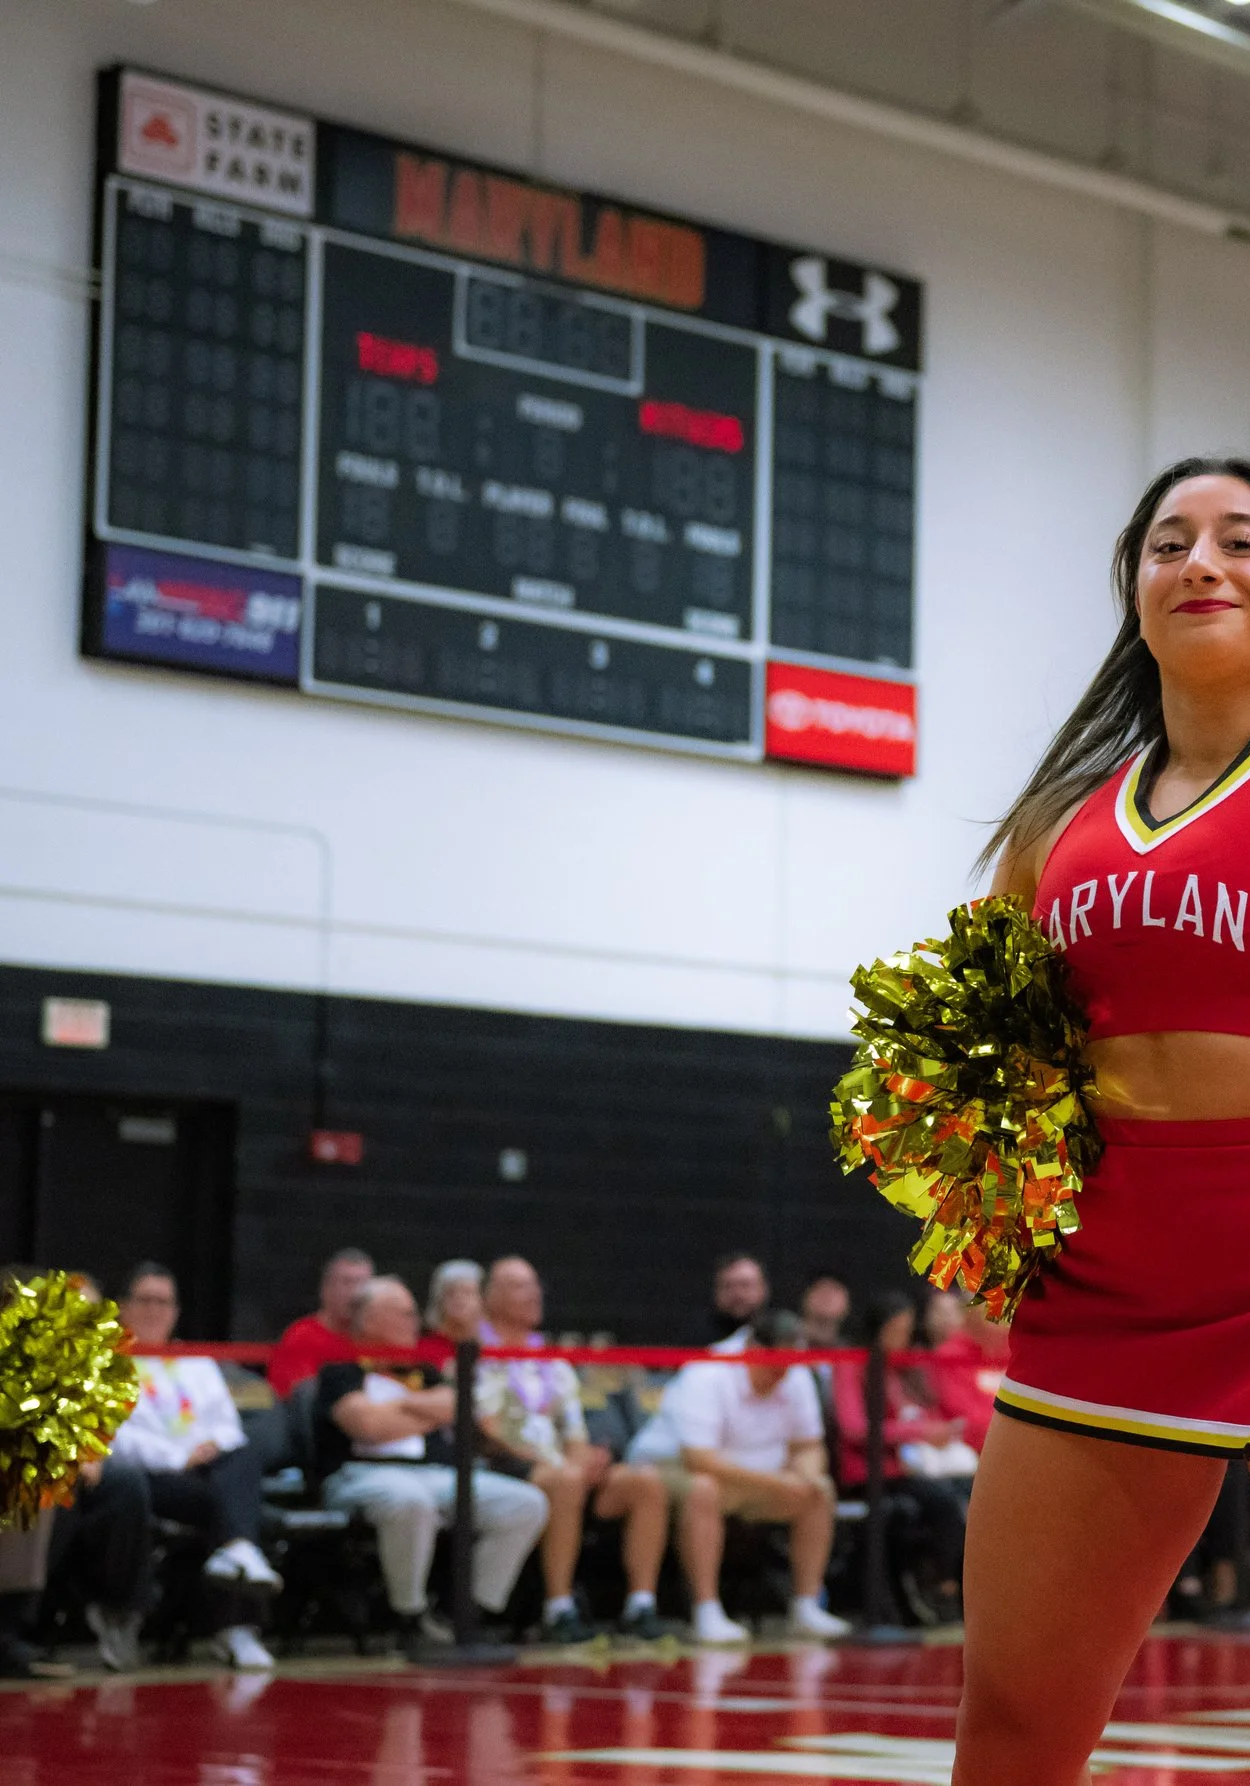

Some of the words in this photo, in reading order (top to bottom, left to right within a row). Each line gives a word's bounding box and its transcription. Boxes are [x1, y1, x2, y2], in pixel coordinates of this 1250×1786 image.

[206, 110, 306, 161] STATE
[204, 150, 303, 196] FARM
[393, 151, 706, 311] MARYLAND
